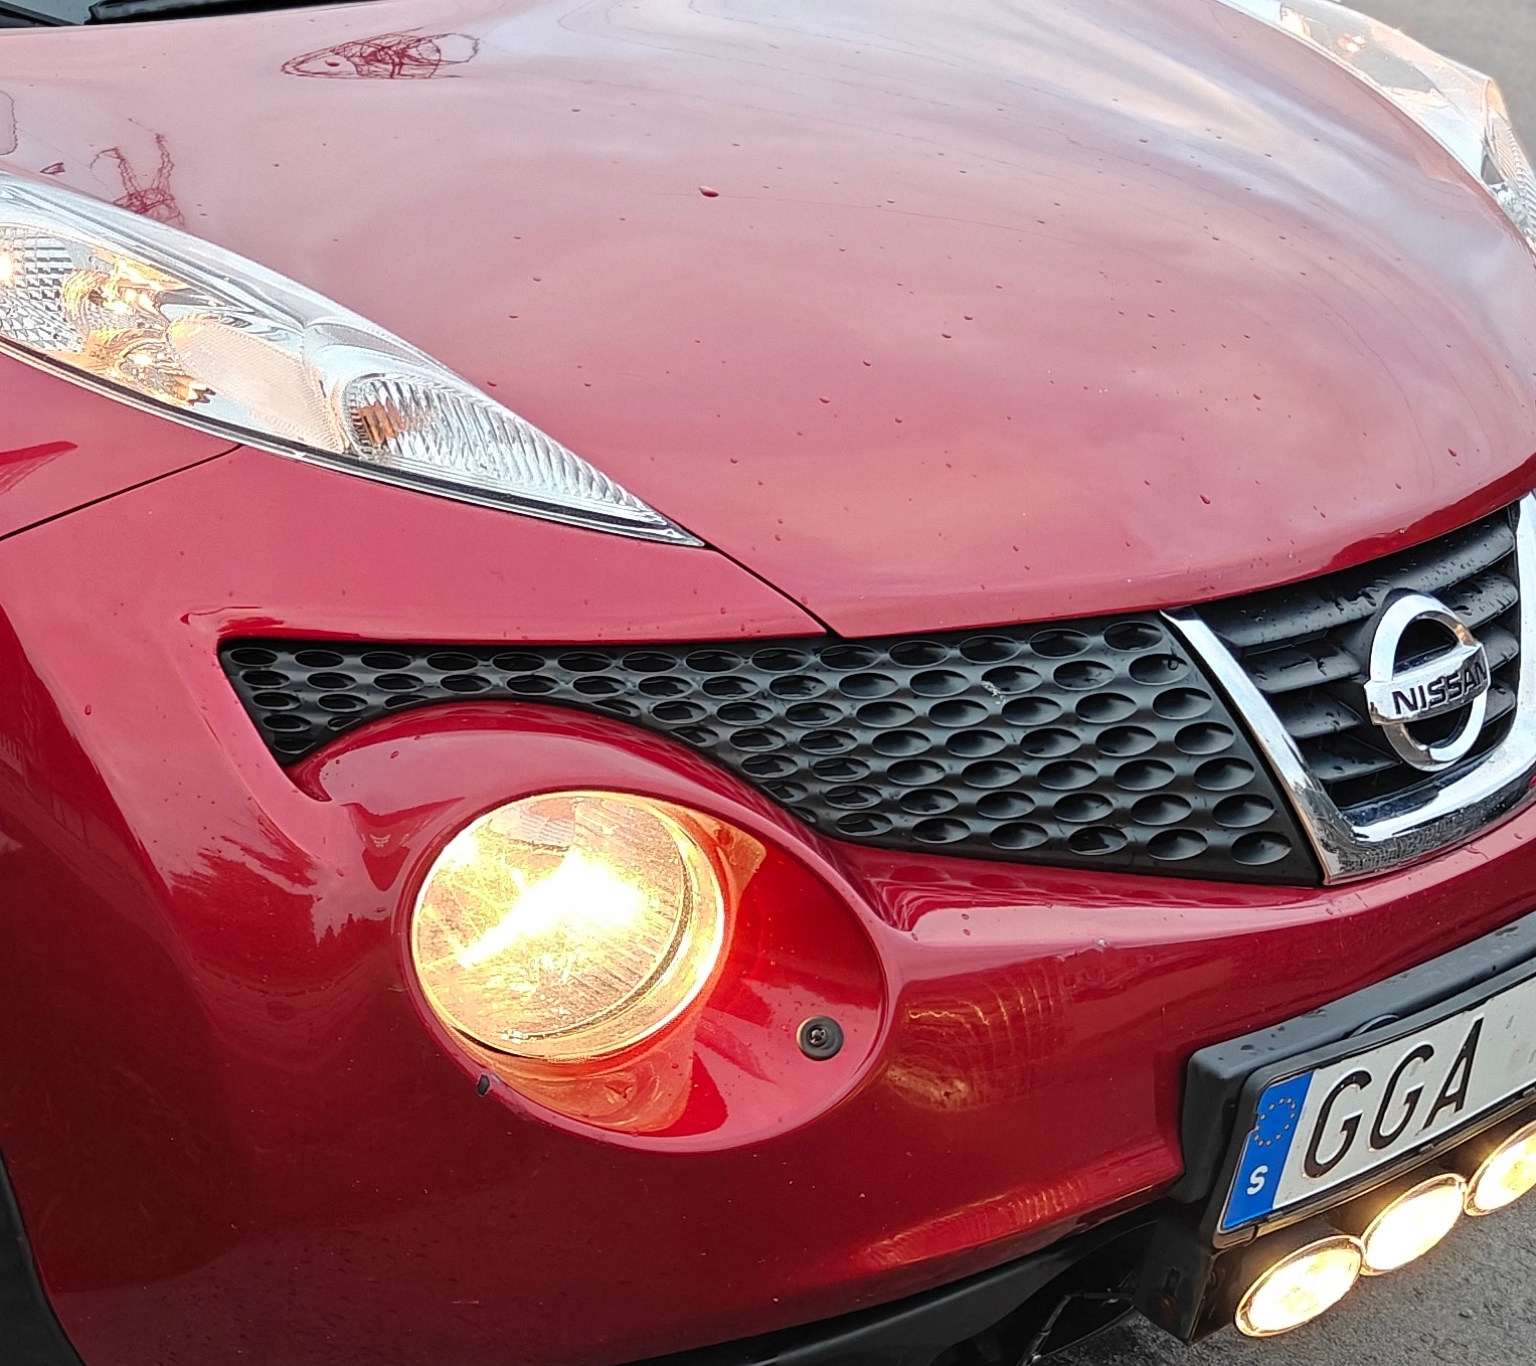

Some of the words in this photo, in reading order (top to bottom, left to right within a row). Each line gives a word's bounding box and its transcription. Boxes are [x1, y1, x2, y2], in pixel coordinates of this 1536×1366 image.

[1391, 661, 1488, 715] NISSAN
[1303, 1016, 1485, 1179] GGA
[1246, 1165, 1268, 1196] S
